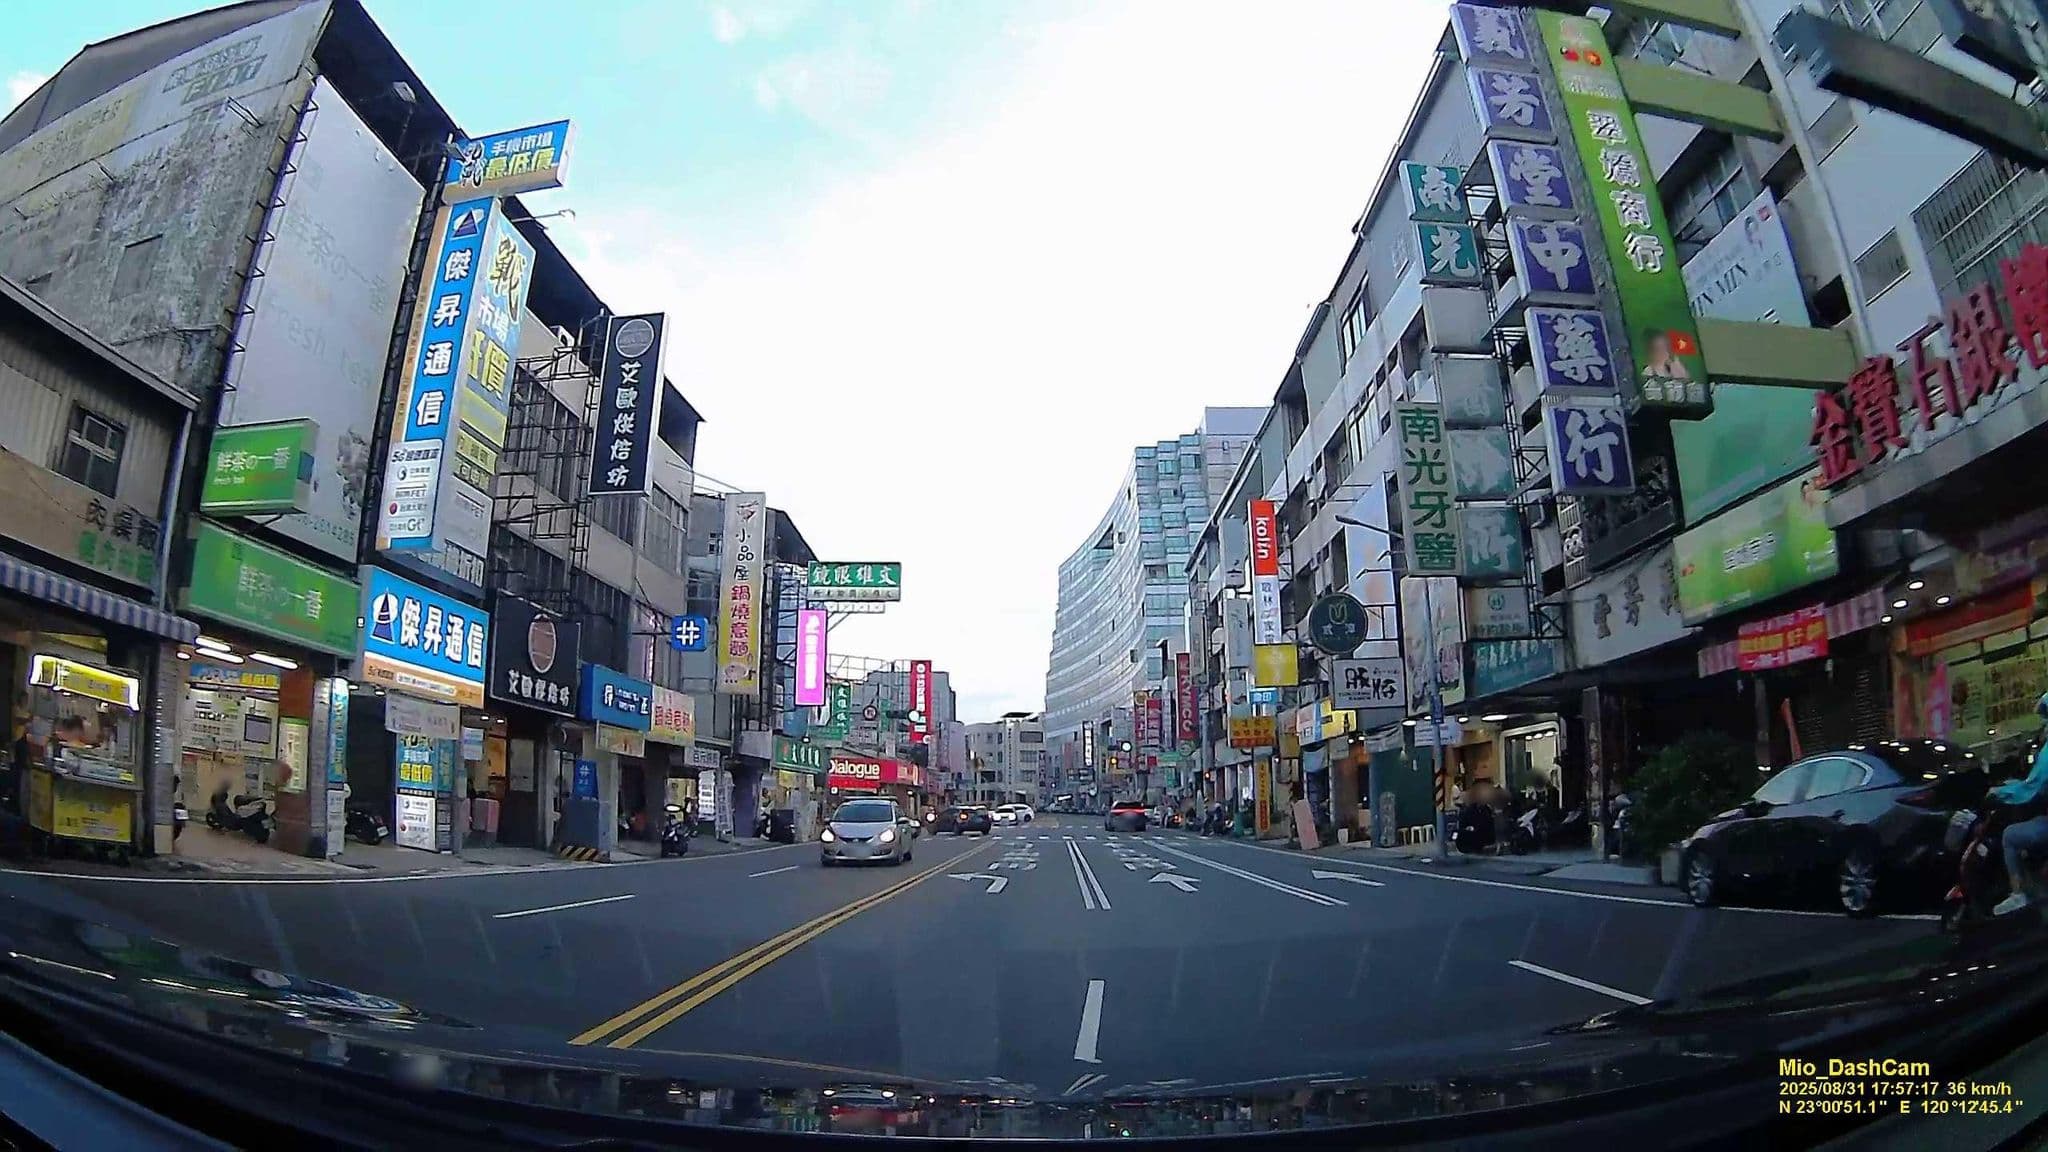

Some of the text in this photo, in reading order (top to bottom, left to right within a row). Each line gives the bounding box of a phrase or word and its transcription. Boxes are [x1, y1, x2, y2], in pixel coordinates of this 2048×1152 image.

[1419, 166, 1477, 278] 南光
[416, 249, 471, 426] 傑昇通信
[607, 361, 642, 487] 艾歐烘焙坊
[1256, 517, 1270, 559] kolin
[1399, 409, 1457, 570] 南光牙醫
[401, 597, 484, 669] 傑昇通信
